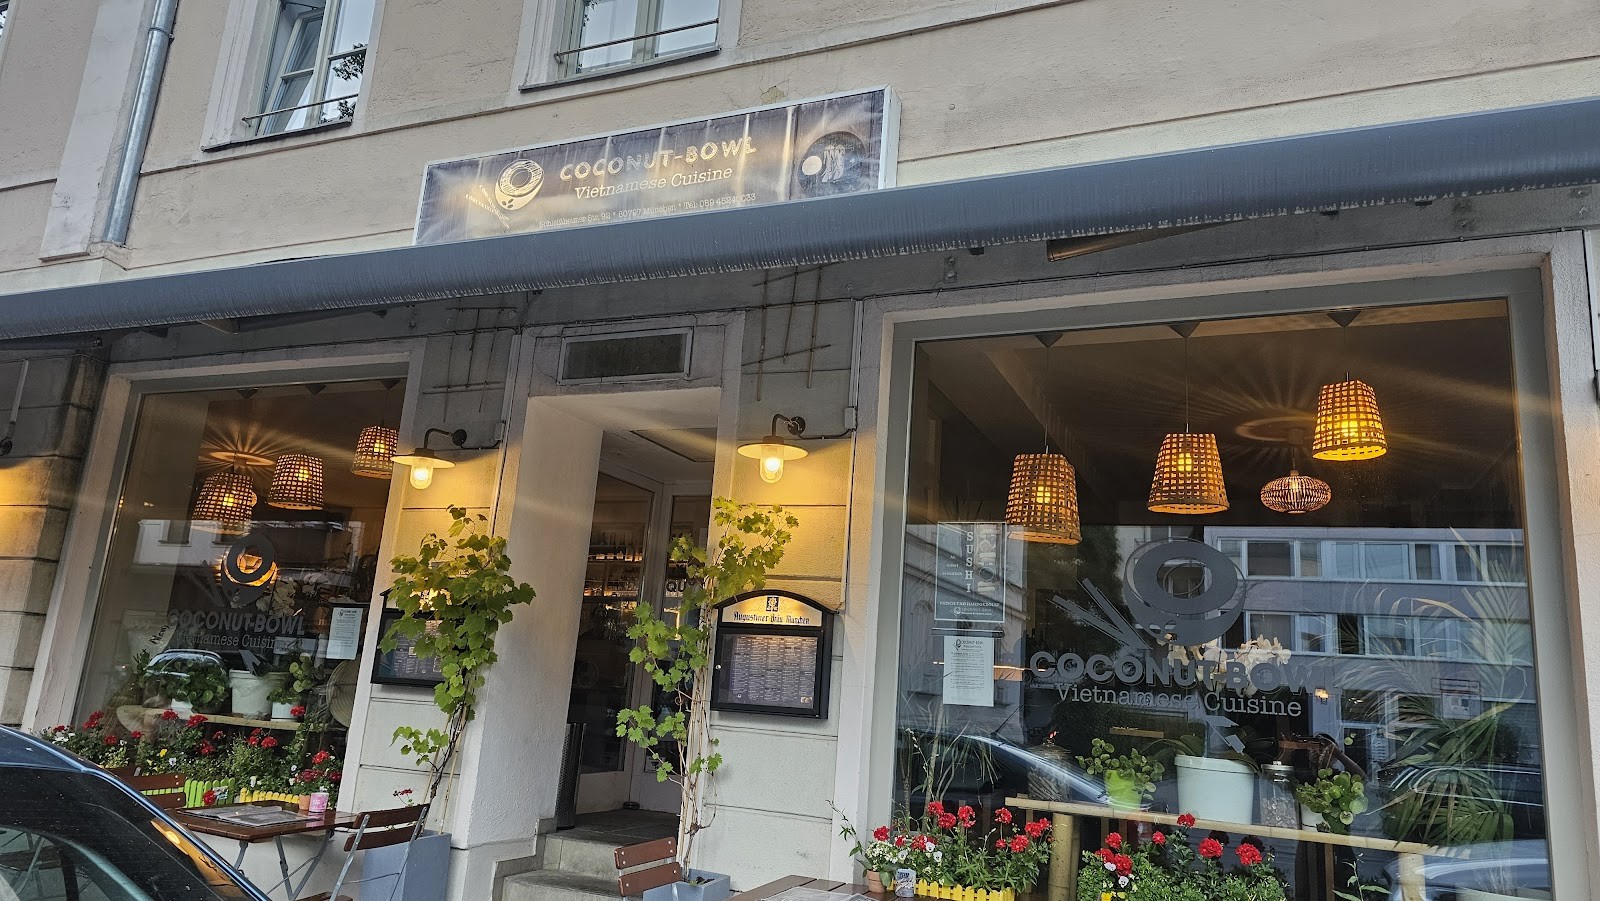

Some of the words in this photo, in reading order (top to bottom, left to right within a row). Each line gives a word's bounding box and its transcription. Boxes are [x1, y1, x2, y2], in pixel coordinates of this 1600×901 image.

[559, 136, 757, 182] COCONUT-BOWL
[575, 176, 667, 200] Vietnamese
[671, 167, 732, 187] Cuisine
[699, 198, 714, 208] 089
[965, 531, 974, 593] SUSHI
[168, 608, 305, 636] COCONUT-BOWL
[733, 611, 769, 622] Augustiner
[1055, 682, 1199, 711] Vietnamese
[1204, 691, 1302, 717] Cuisine
